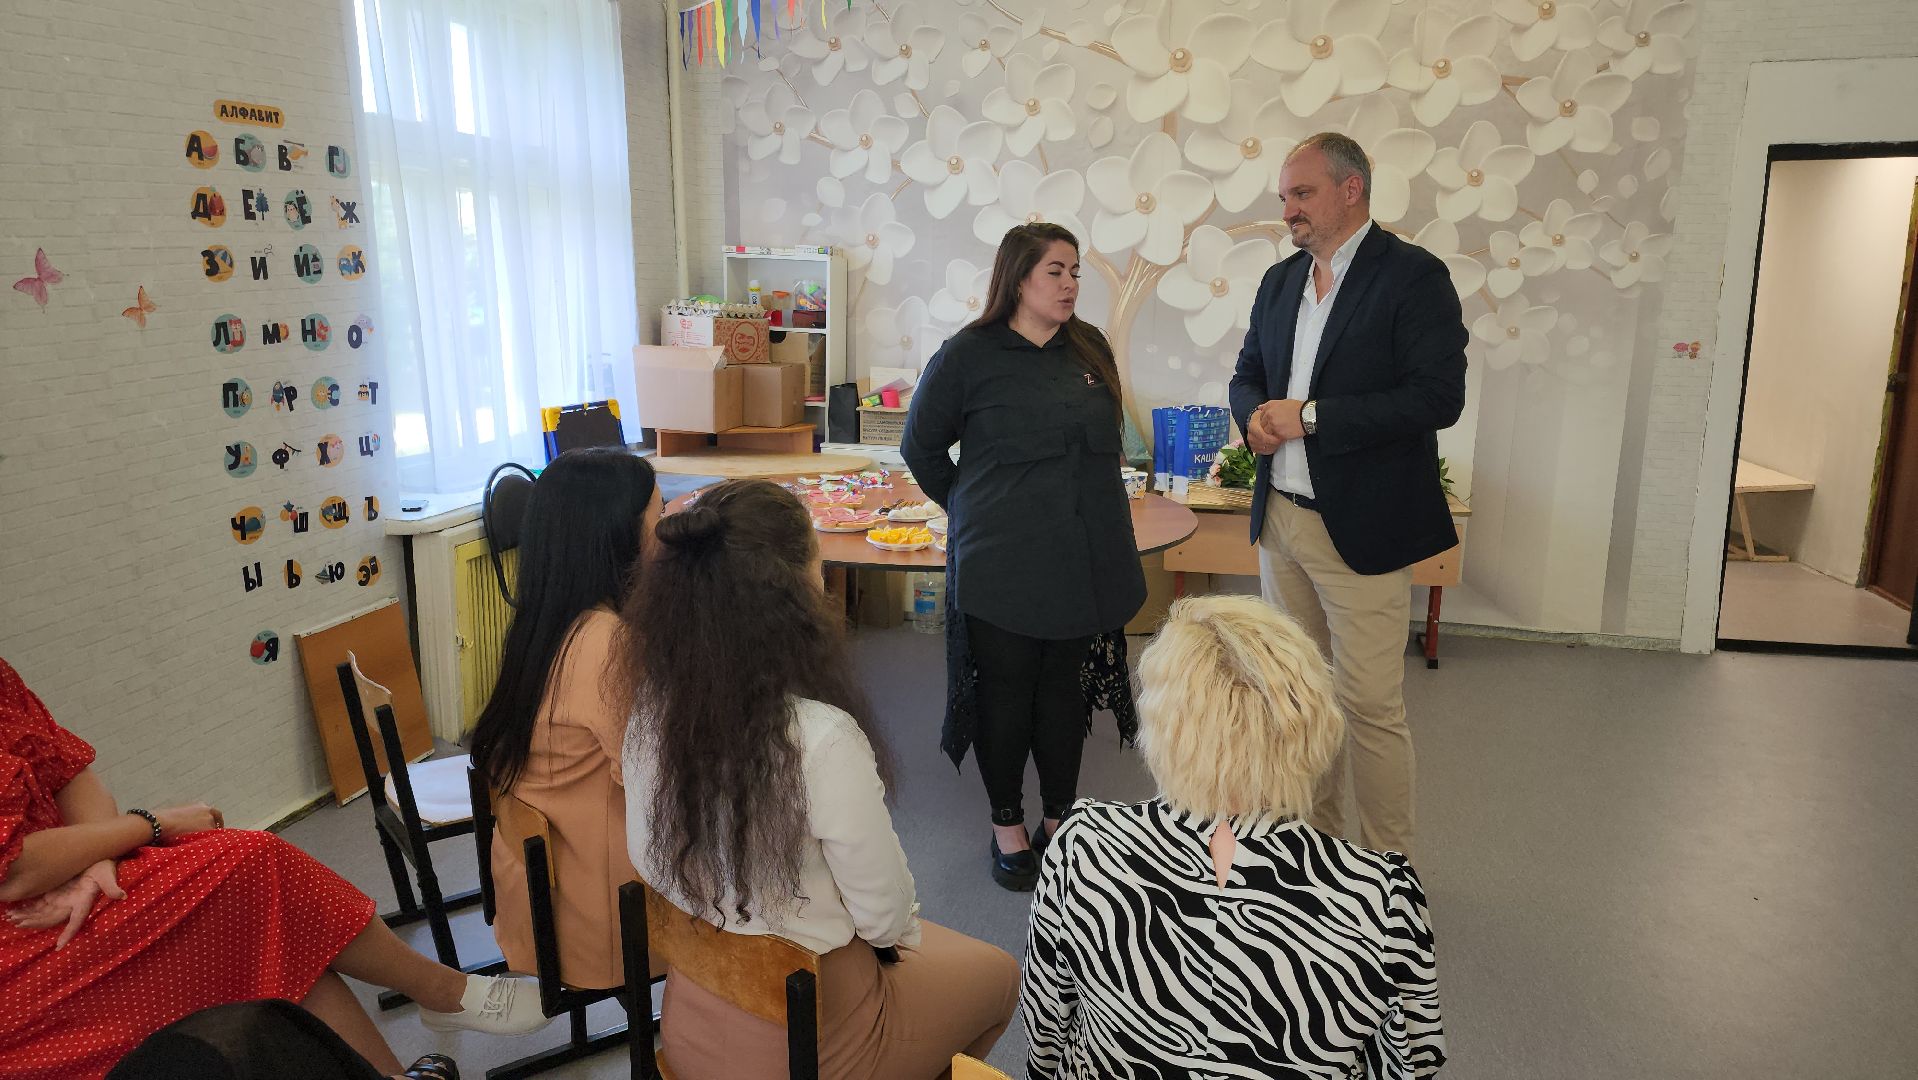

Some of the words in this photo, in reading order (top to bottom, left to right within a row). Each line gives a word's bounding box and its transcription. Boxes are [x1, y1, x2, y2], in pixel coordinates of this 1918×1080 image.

[220, 105, 280, 124] АЛФАВИТ
[186, 134, 204, 161] А
[234, 138, 249, 165] Б
[278, 144, 291, 171] В
[328, 146, 339, 172] Г
[191, 193, 212, 221] Д
[242, 189, 256, 220] Е
[295, 190, 311, 225] Ё
[340, 202, 360, 223] Ж
[201, 250, 219, 276] З
[250, 257, 268, 280] И
[294, 246, 310, 277] Й
[351, 251, 365, 273] К
[213, 321, 230, 347] Л
[262, 323, 281, 345] М
[301, 318, 316, 342] Н
[348, 324, 362, 349] О
[222, 383, 239, 408] П
[283, 386, 297, 412] Р
[327, 383, 341, 406] С
[369, 382, 378, 405] Т
[226, 444, 241, 470] У
[272, 448, 289, 469] Ф
[317, 442, 331, 466] Х
[359, 435, 373, 457] Ц
[231, 516, 246, 540] Ч
[293, 512, 309, 533] Ш
[332, 502, 349, 523] Щ
[365, 496, 378, 521] Ъ
[242, 562, 263, 592] Ы
[287, 559, 300, 589] Ь
[328, 561, 345, 583] Ю
[358, 565, 370, 586] Э
[264, 637, 278, 662] Я
